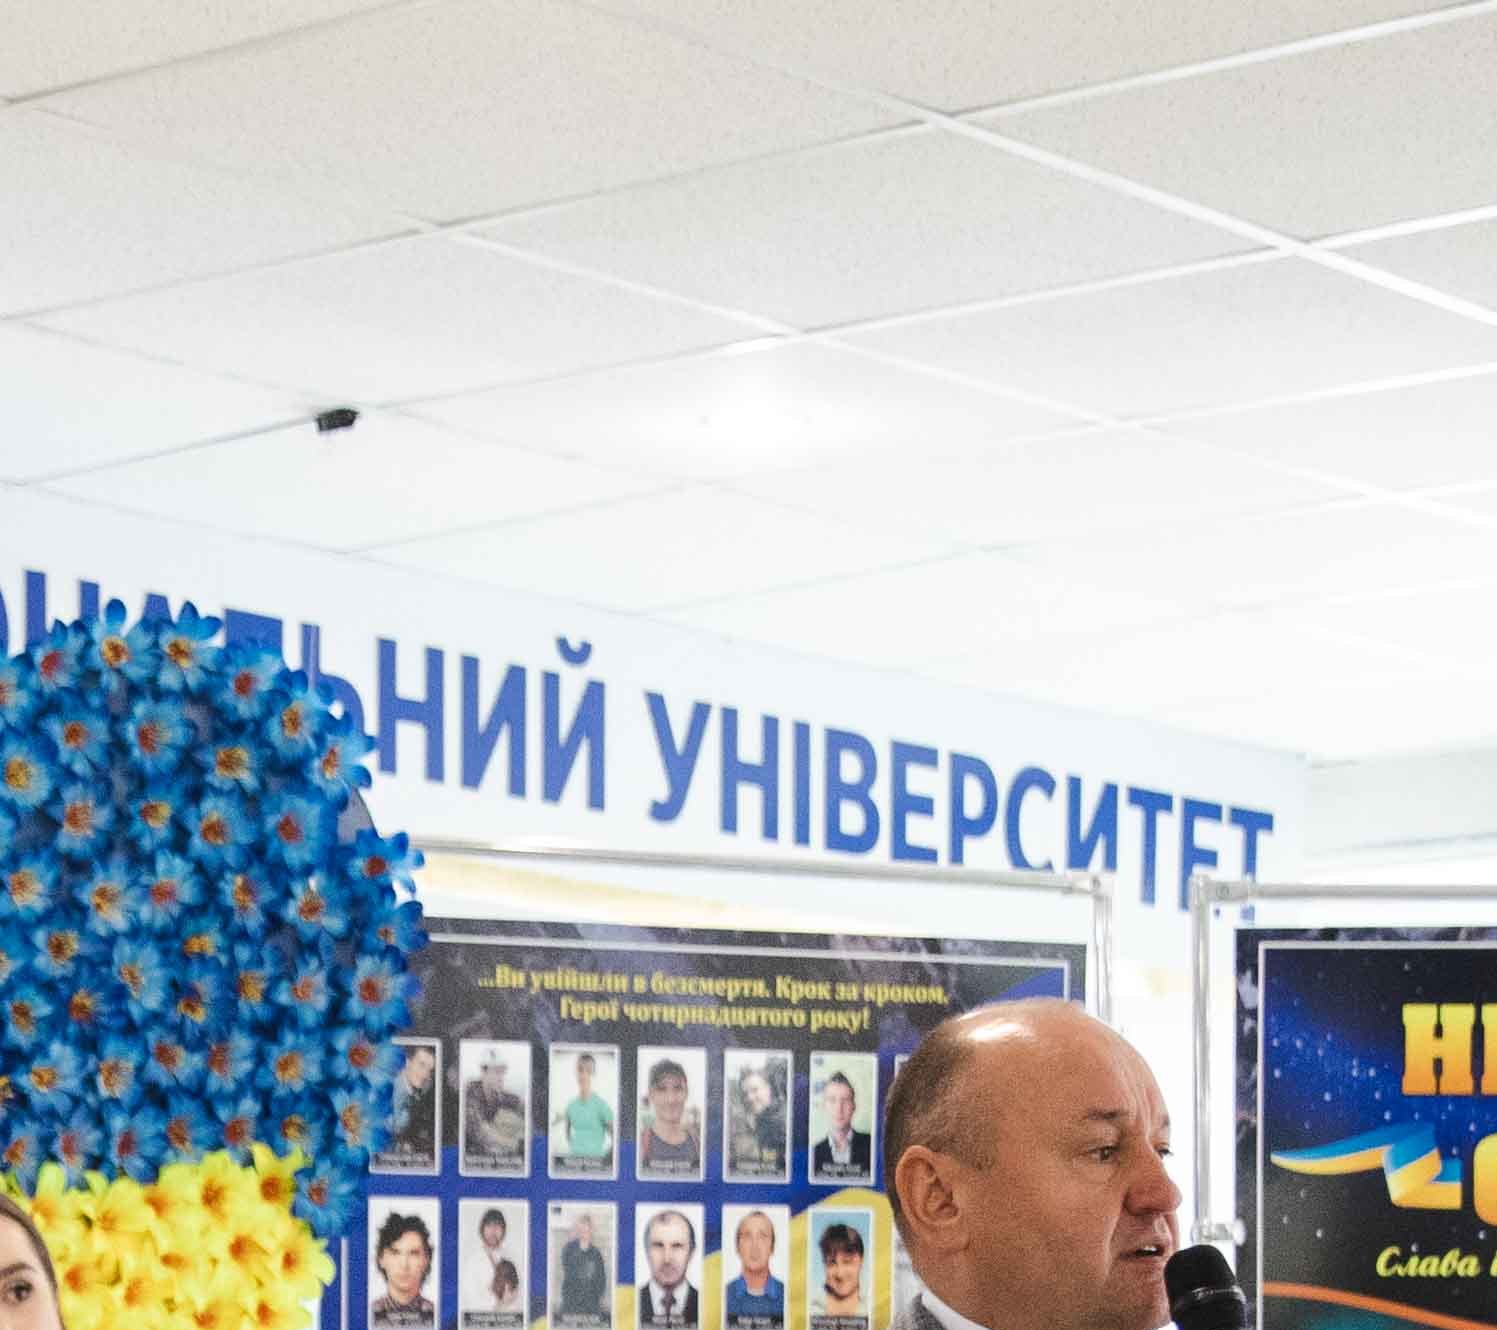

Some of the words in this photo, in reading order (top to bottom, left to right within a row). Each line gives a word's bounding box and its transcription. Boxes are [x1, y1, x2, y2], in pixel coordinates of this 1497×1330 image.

[645, 692, 1274, 920] УНІВЕРСИТЕТ
[531, 967, 628, 992] увійшли
[633, 974, 646, 993] в
[651, 969, 769, 1002] безсмертя.
[775, 976, 831, 1003] Крок
[835, 982, 857, 1000] за
[561, 994, 620, 1025] Герої
[624, 1001, 806, 1030] чотирнадцятого
[810, 1006, 871, 1034] року!
[1376, 1245, 1480, 1278] Слава
